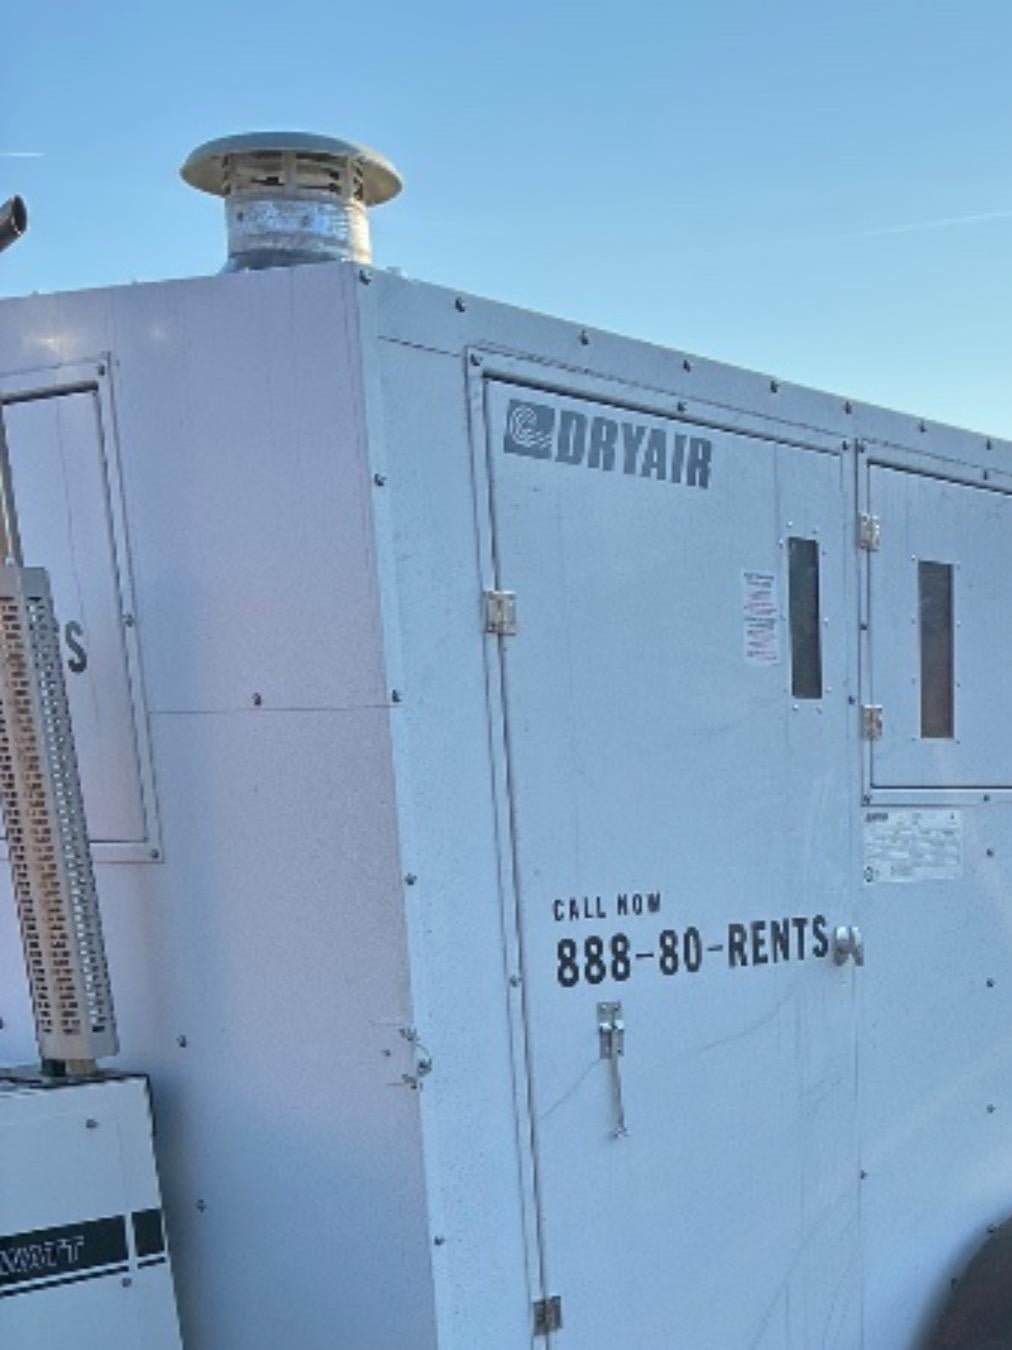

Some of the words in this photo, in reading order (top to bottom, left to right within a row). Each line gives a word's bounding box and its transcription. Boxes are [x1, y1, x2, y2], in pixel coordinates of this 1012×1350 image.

[555, 410, 711, 489] DRYAIR
[553, 898, 606, 921] CALL
[617, 892, 661, 915] NOW
[556, 915, 828, 987] 888-80-RENTS
